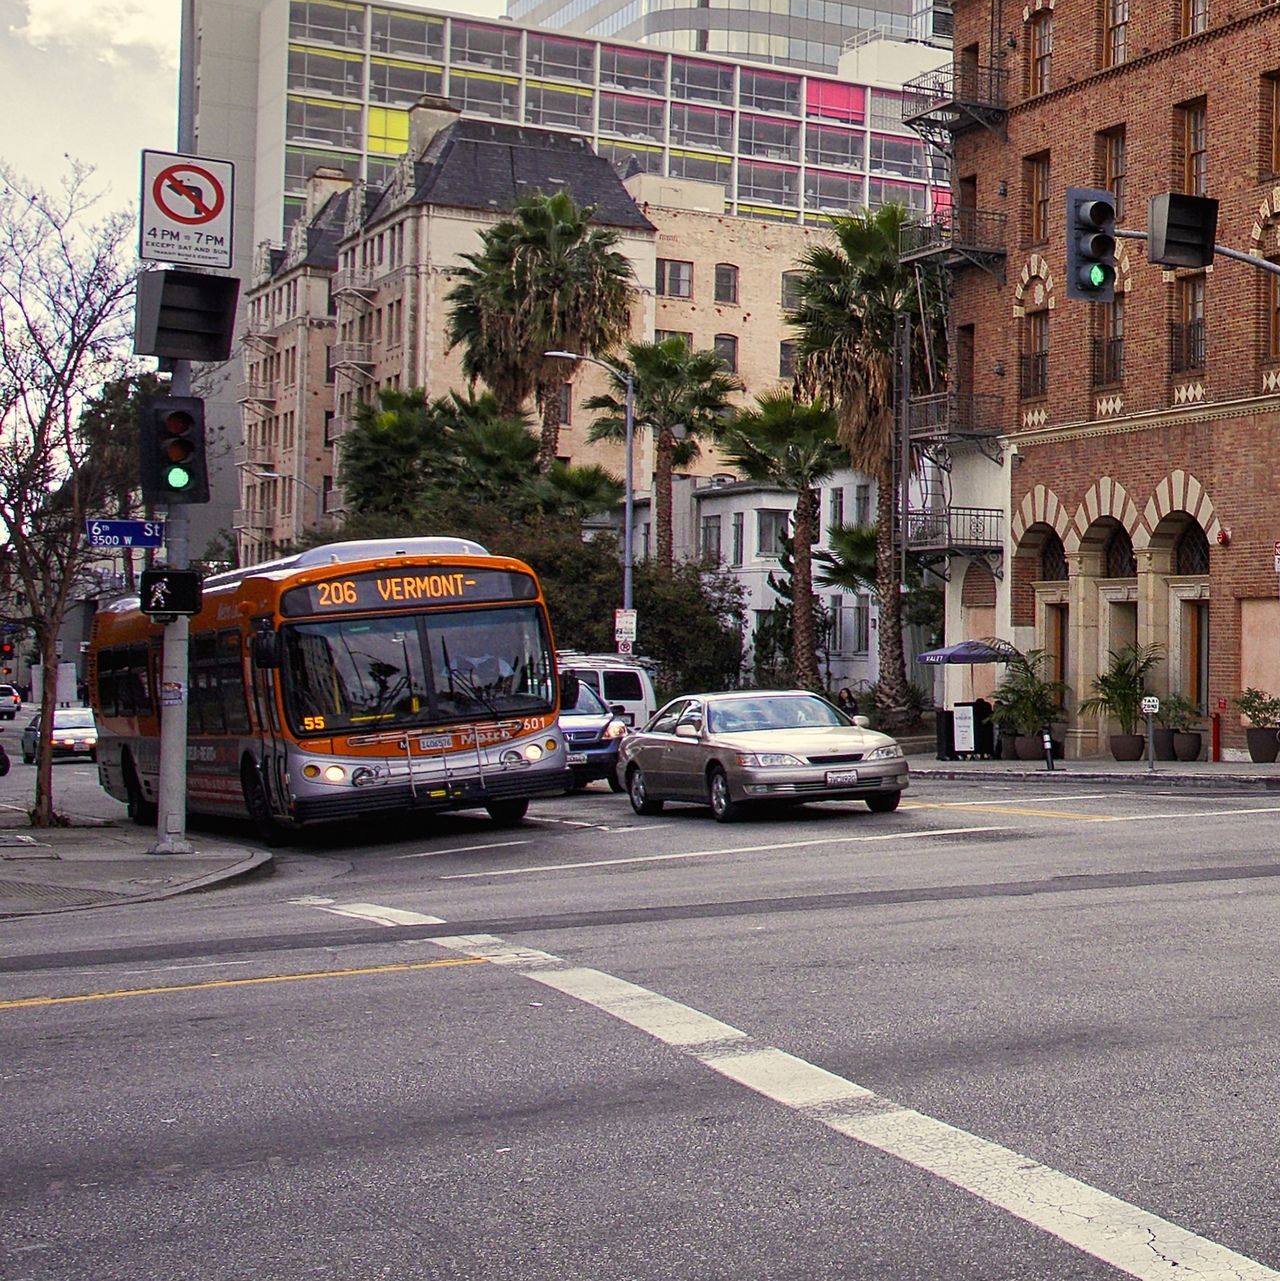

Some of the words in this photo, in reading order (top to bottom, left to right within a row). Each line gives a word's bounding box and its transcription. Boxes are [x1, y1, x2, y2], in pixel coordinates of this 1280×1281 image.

[147, 227, 157, 238] 4
[161, 230, 180, 240] PM
[194, 232, 203, 244] 7
[205, 235, 224, 246] PM
[92, 522, 109, 535] 6th
[144, 523, 160, 536] St
[91, 536, 119, 545] 3500
[124, 536, 133, 545] W
[317, 582, 358, 606] 206
[304, 717, 324, 730] 55
[517, 717, 546, 730] 601
